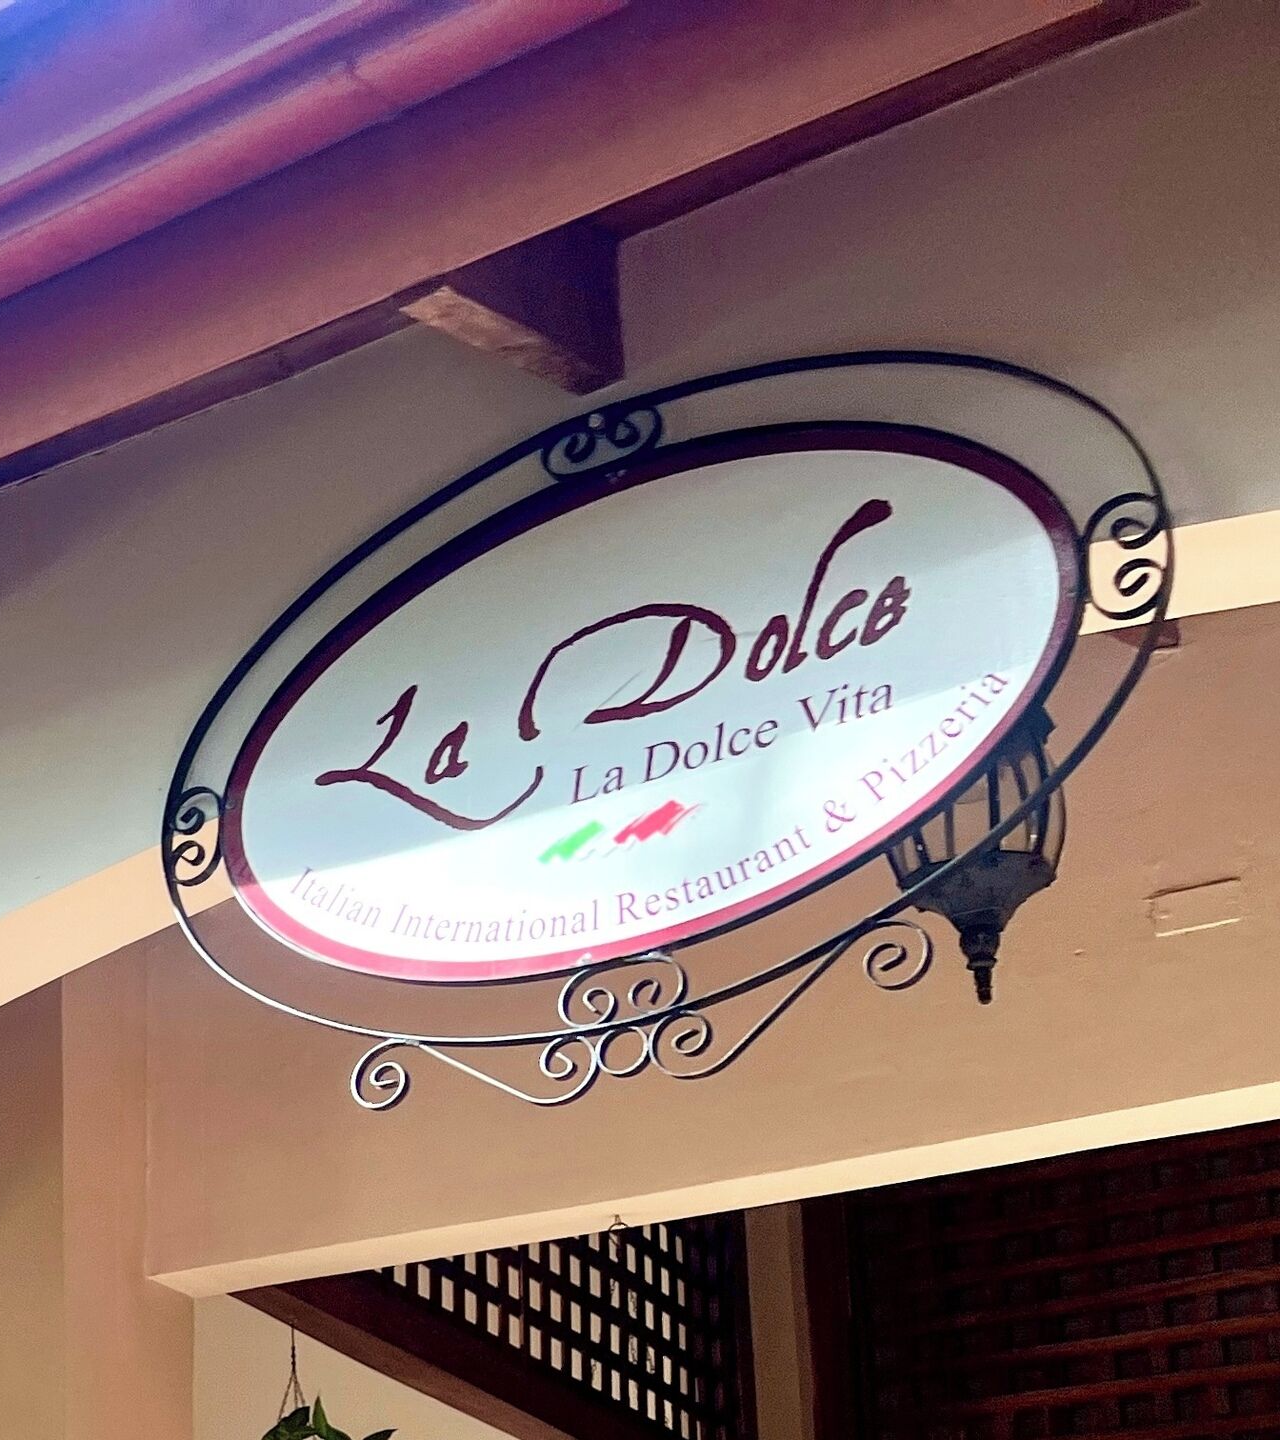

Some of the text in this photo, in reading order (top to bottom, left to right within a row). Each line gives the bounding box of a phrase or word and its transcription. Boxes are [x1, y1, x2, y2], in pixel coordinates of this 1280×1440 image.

[315, 499, 911, 831] La Dolce
[570, 683, 894, 804] La Dolce Vita
[289, 670, 1009, 943] Italian International Restaurant & Pizzeria
